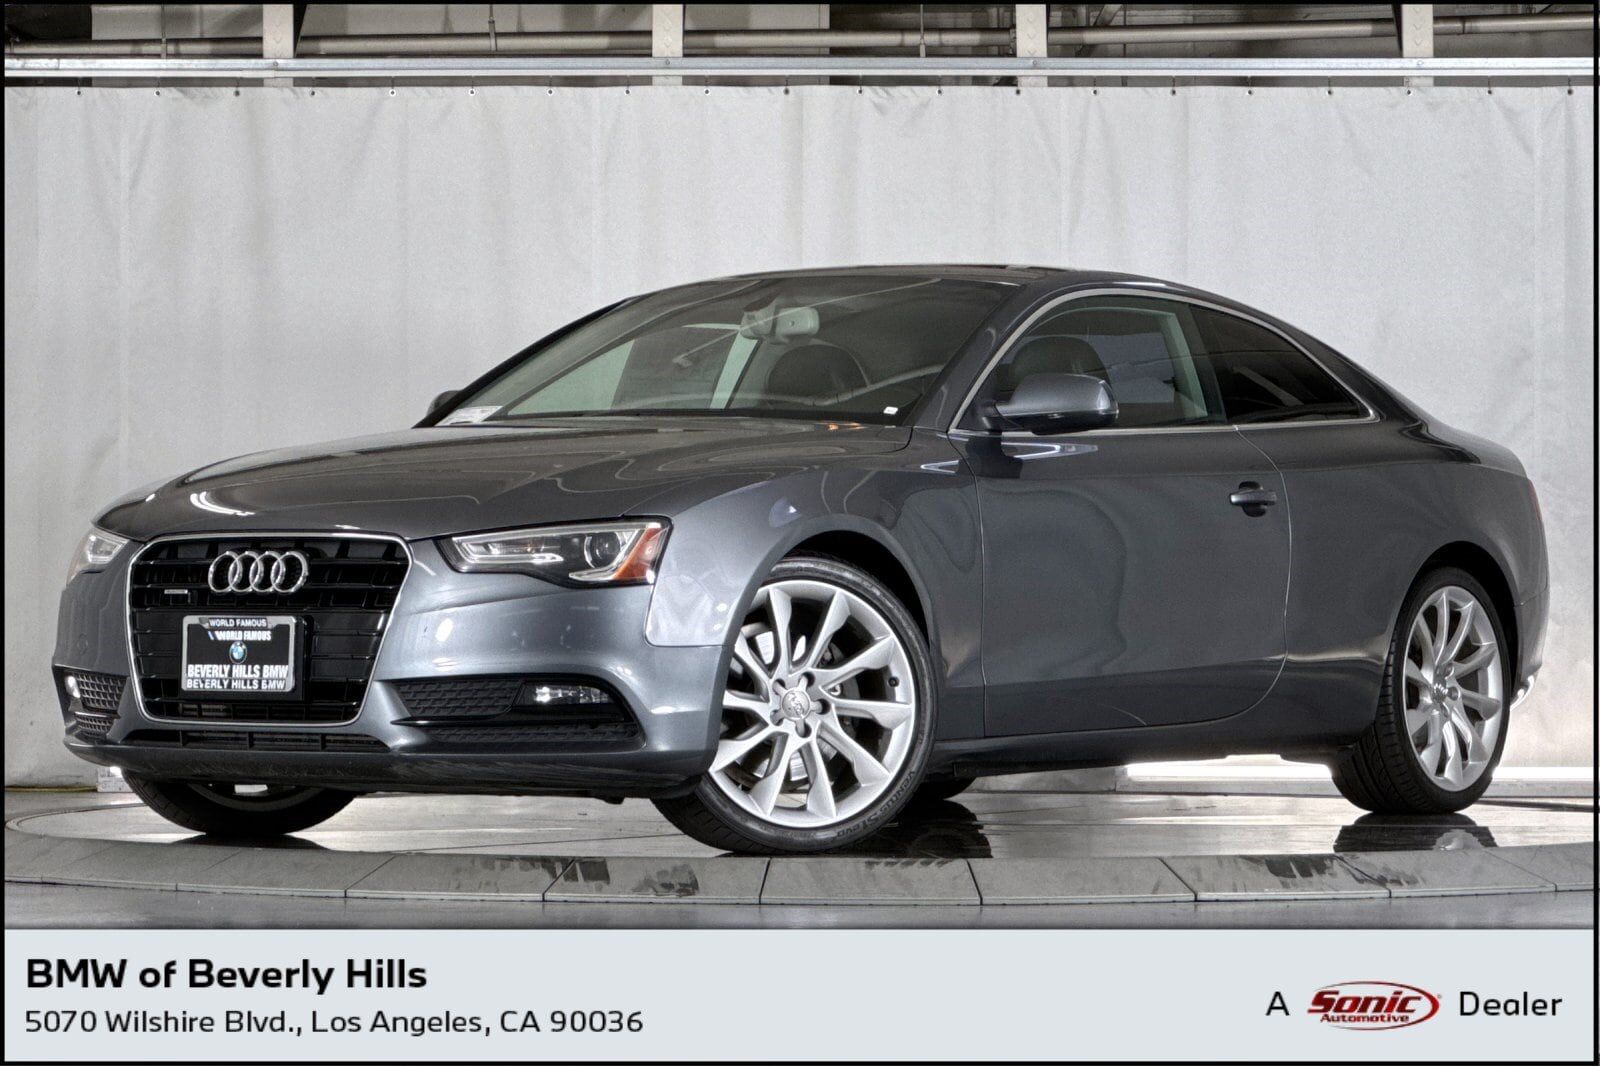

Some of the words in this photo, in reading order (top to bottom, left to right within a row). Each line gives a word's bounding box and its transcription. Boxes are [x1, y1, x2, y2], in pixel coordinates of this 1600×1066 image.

[209, 619, 234, 627] WORLD
[236, 619, 267, 627] FAMOUS
[214, 631, 242, 641] WORLD
[243, 631, 271, 641] FAMOUS
[188, 664, 230, 678] BEVERLY
[232, 664, 260, 678] HILLS
[263, 664, 288, 678] BMW
[187, 679, 228, 689] BEVERLY
[231, 679, 259, 689] HILLS
